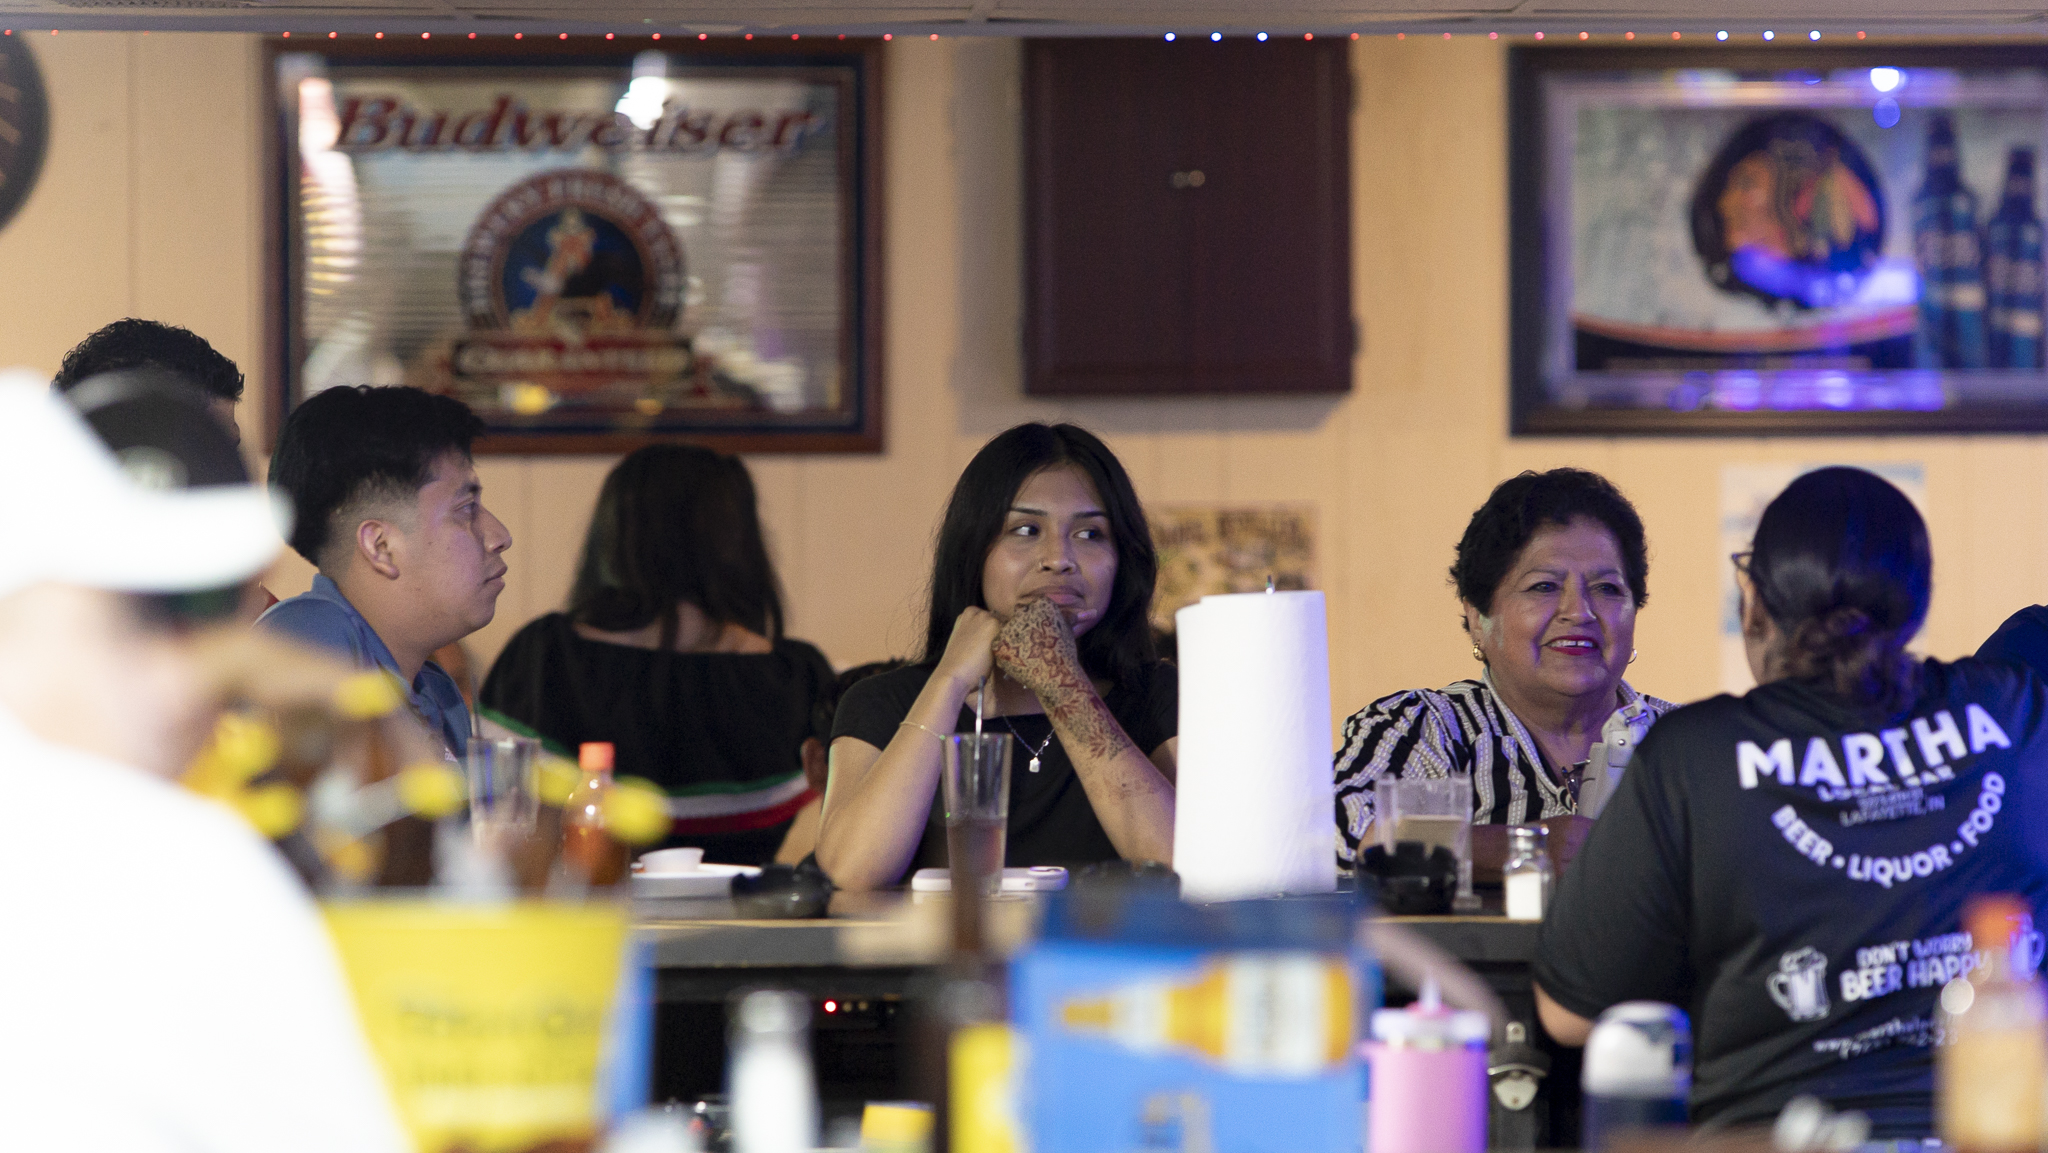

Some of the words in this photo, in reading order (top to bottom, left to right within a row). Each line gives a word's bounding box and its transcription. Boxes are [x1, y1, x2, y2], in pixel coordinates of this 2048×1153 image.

[336, 96, 818, 148] Budweiser
[1736, 703, 2012, 789] MARTHA
[1771, 804, 1833, 866] BEER
[1848, 844, 1953, 889] LIQUOR
[1957, 771, 2005, 847] FOOD
[1840, 962, 1903, 1002] BEER
[1907, 951, 1991, 989] HAPPY
